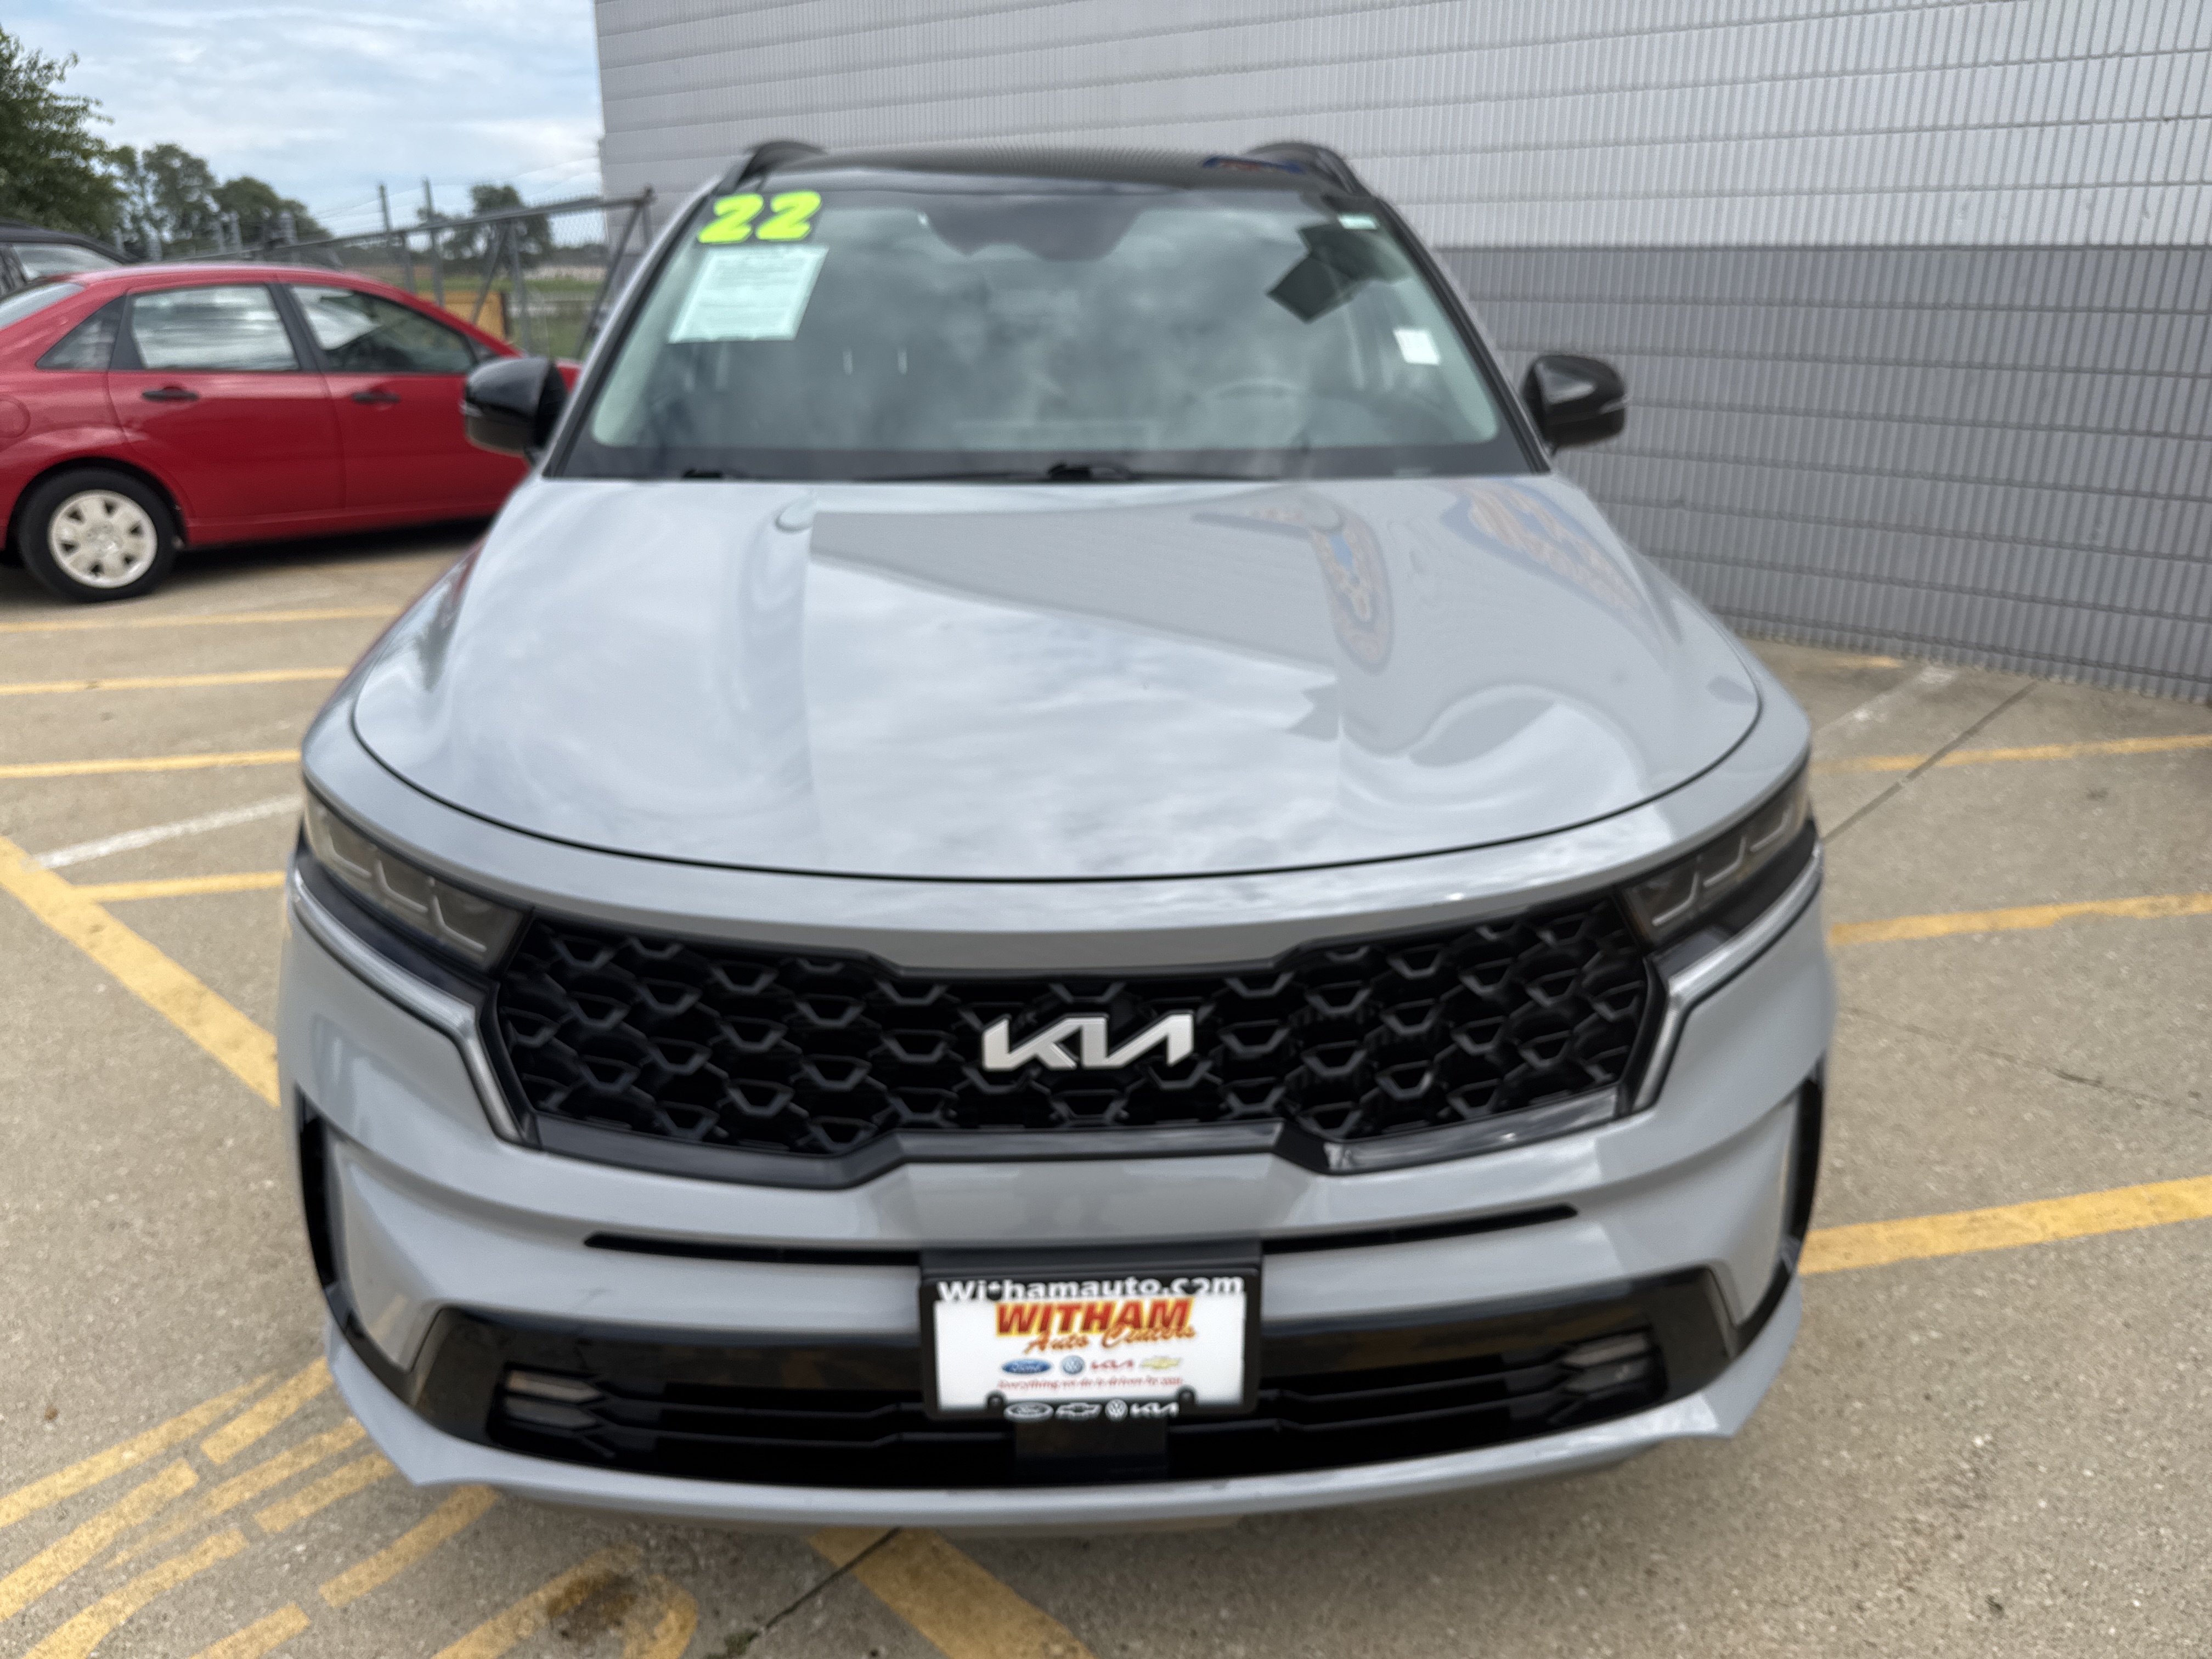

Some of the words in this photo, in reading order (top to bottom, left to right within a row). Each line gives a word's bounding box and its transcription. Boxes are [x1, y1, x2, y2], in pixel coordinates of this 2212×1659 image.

[697, 190, 822, 244] 22
[982, 1012, 1195, 1071] KIA
[996, 1296, 1194, 1337] WITHAM
[1130, 1402, 1180, 1419] KIA
